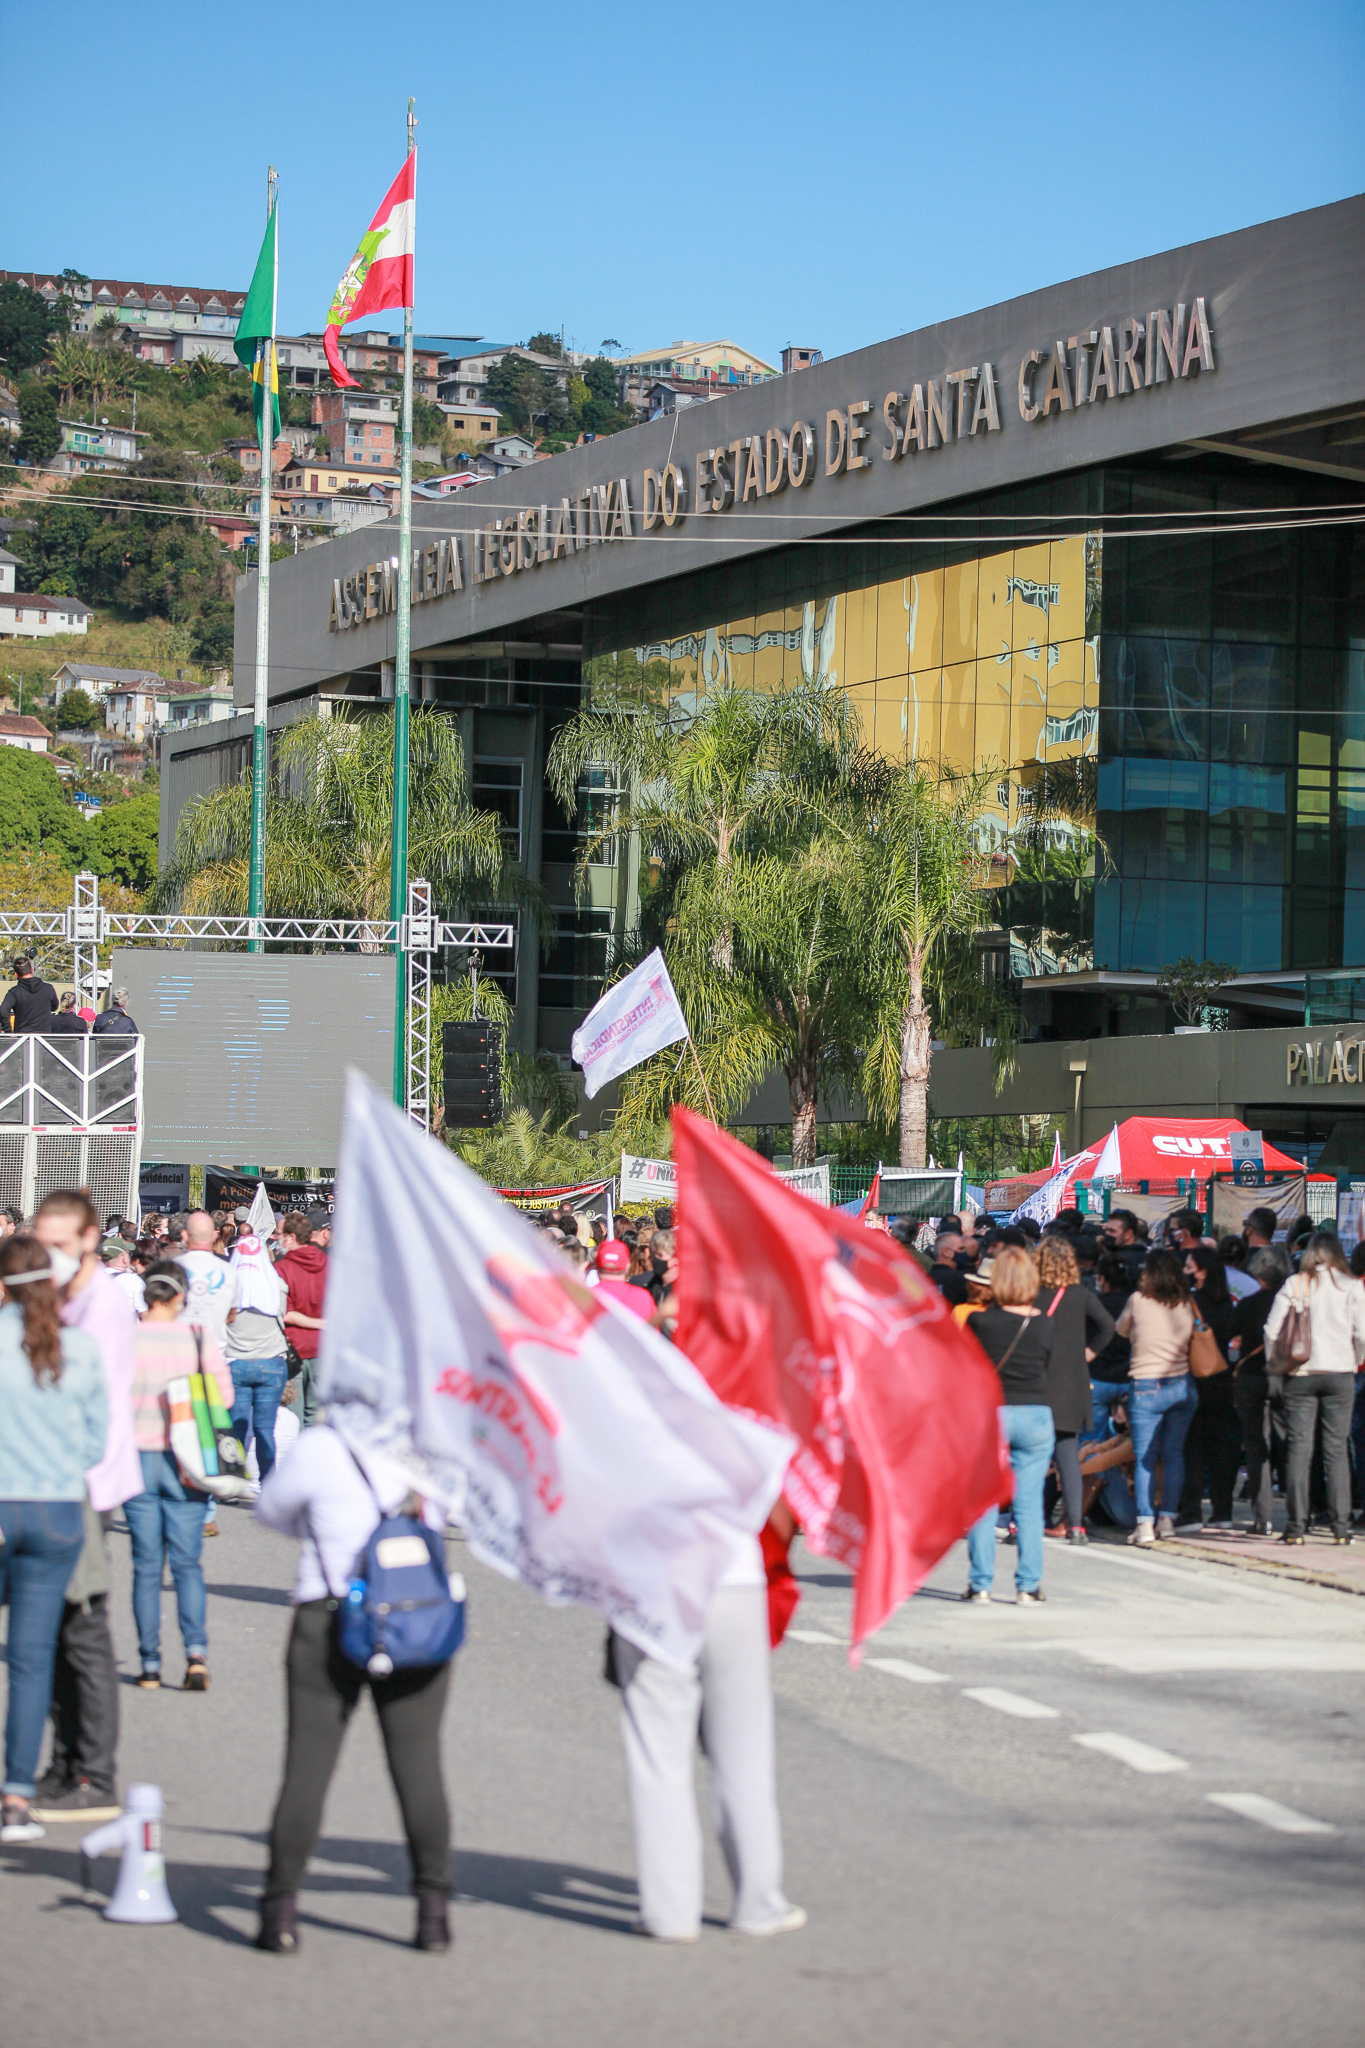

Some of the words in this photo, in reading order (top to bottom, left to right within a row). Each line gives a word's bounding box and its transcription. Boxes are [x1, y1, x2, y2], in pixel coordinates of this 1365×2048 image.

[328, 536, 462, 633] ASSEMLEIA
[472, 479, 632, 585] LEGISLATIVA
[643, 462, 684, 531] DO
[695, 420, 816, 514] ESTADO
[825, 400, 871, 477] DE
[883, 362, 1000, 461] SANTA
[1018, 297, 1215, 422] CATARINA
[1152, 1135, 1227, 1155] CUT
[140, 1173, 184, 1184] evidência!
[220, 1185, 228, 1196] A
